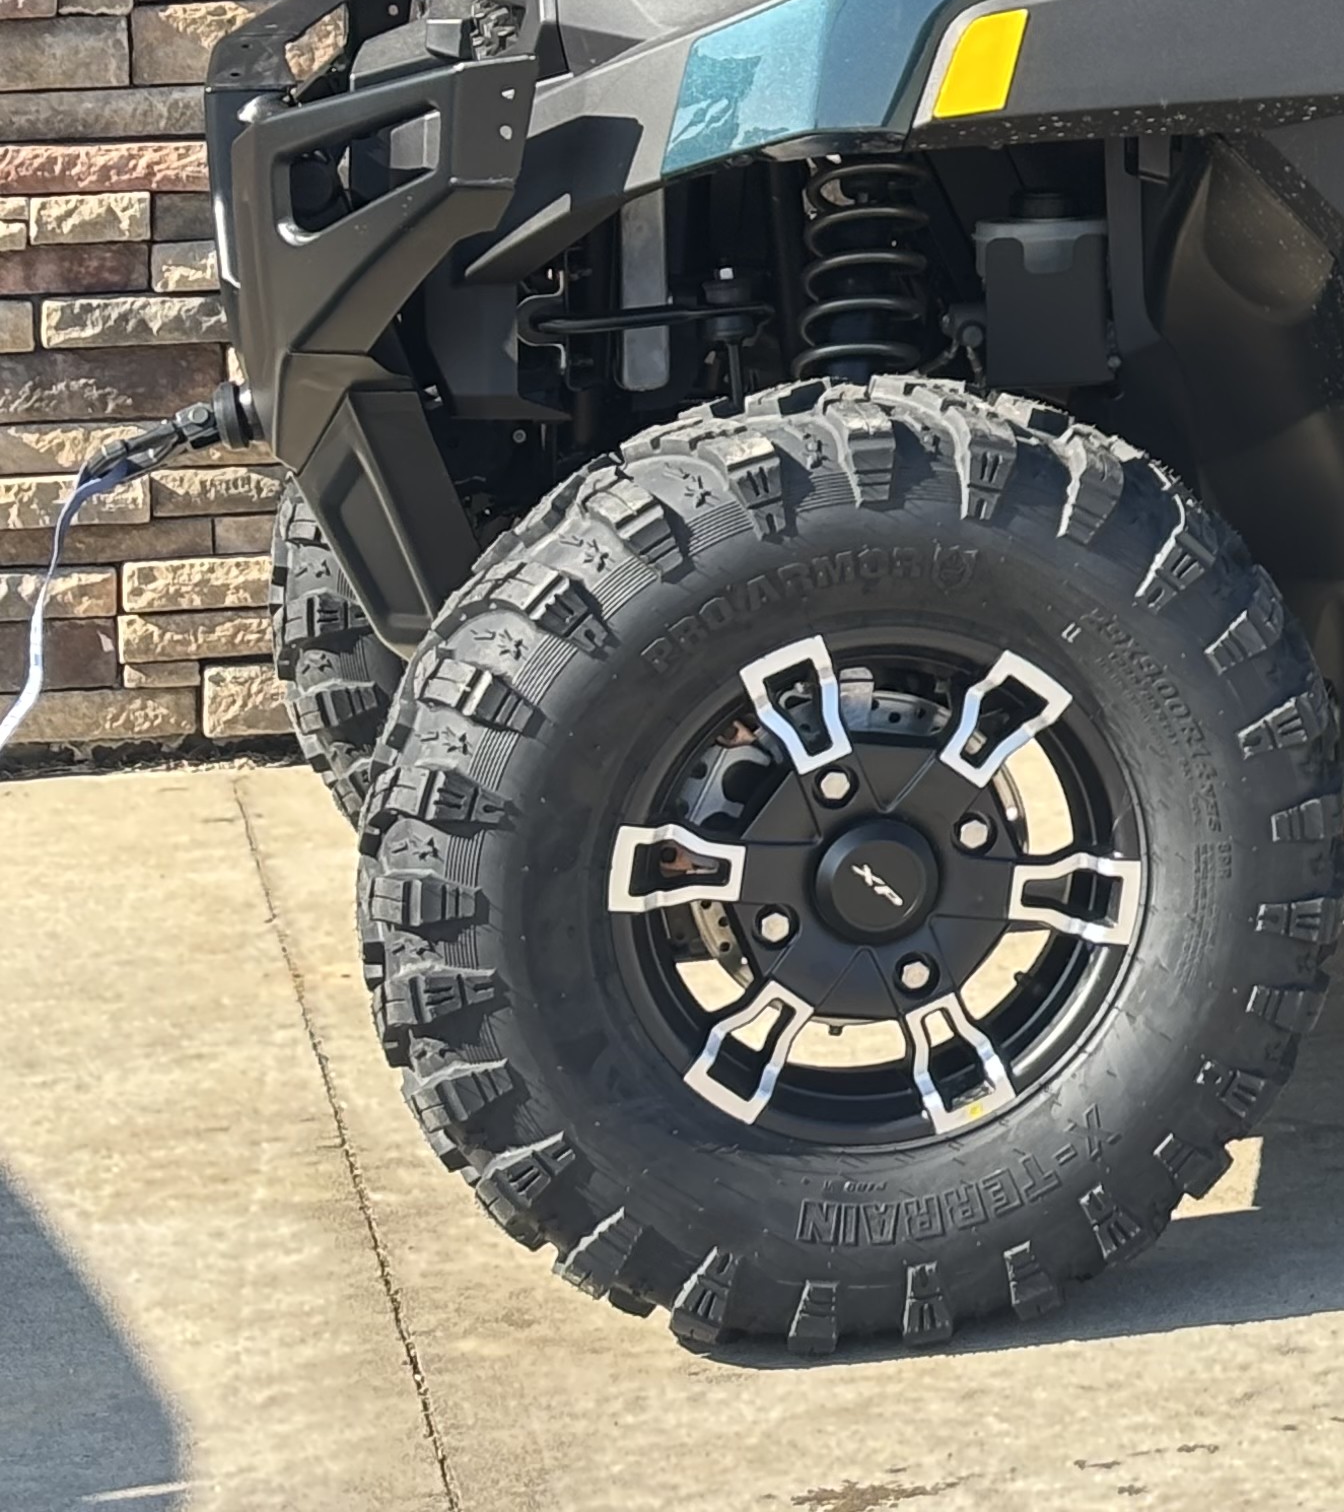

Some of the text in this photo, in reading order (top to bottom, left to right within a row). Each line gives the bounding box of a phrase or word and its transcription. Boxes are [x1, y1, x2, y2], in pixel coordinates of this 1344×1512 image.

[640, 544, 921, 675] PRO ARMOR
[851, 863, 903, 906] XP
[796, 1102, 1121, 1246] X-TERRAIN
